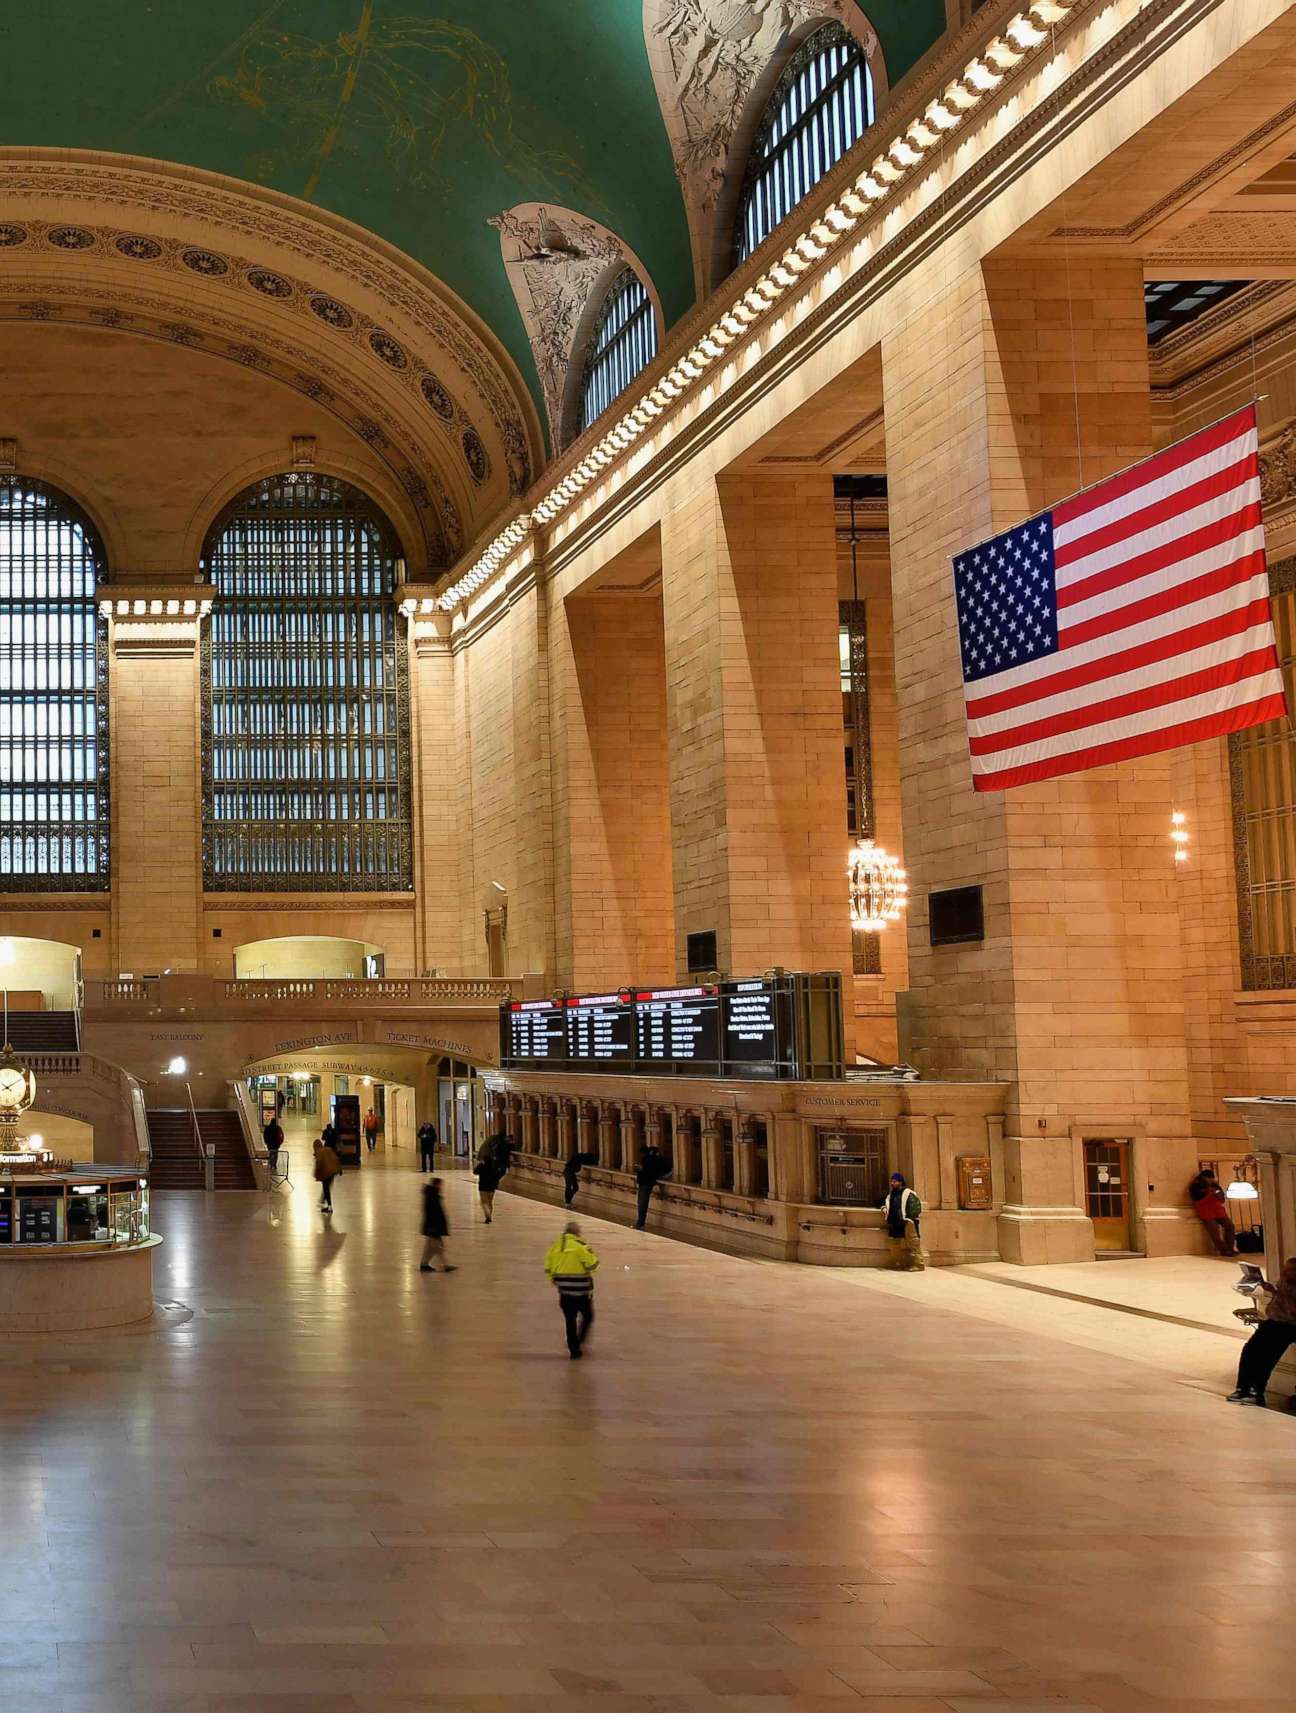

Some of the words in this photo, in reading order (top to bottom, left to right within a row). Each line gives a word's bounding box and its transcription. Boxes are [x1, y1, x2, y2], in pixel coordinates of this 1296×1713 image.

[275, 1033, 331, 1051] LEXINGTON
[334, 1032, 353, 1041] AVE
[386, 1032, 419, 1042] TICKET
[424, 1036, 473, 1053] MACHINES
[251, 1063, 283, 1075] STREET
[284, 1061, 318, 1070] PASSAGE
[321, 1061, 354, 1071] SUBWAY
[805, 1097, 845, 1105] CUSTOMER
[847, 1098, 881, 1106] SERVICE
